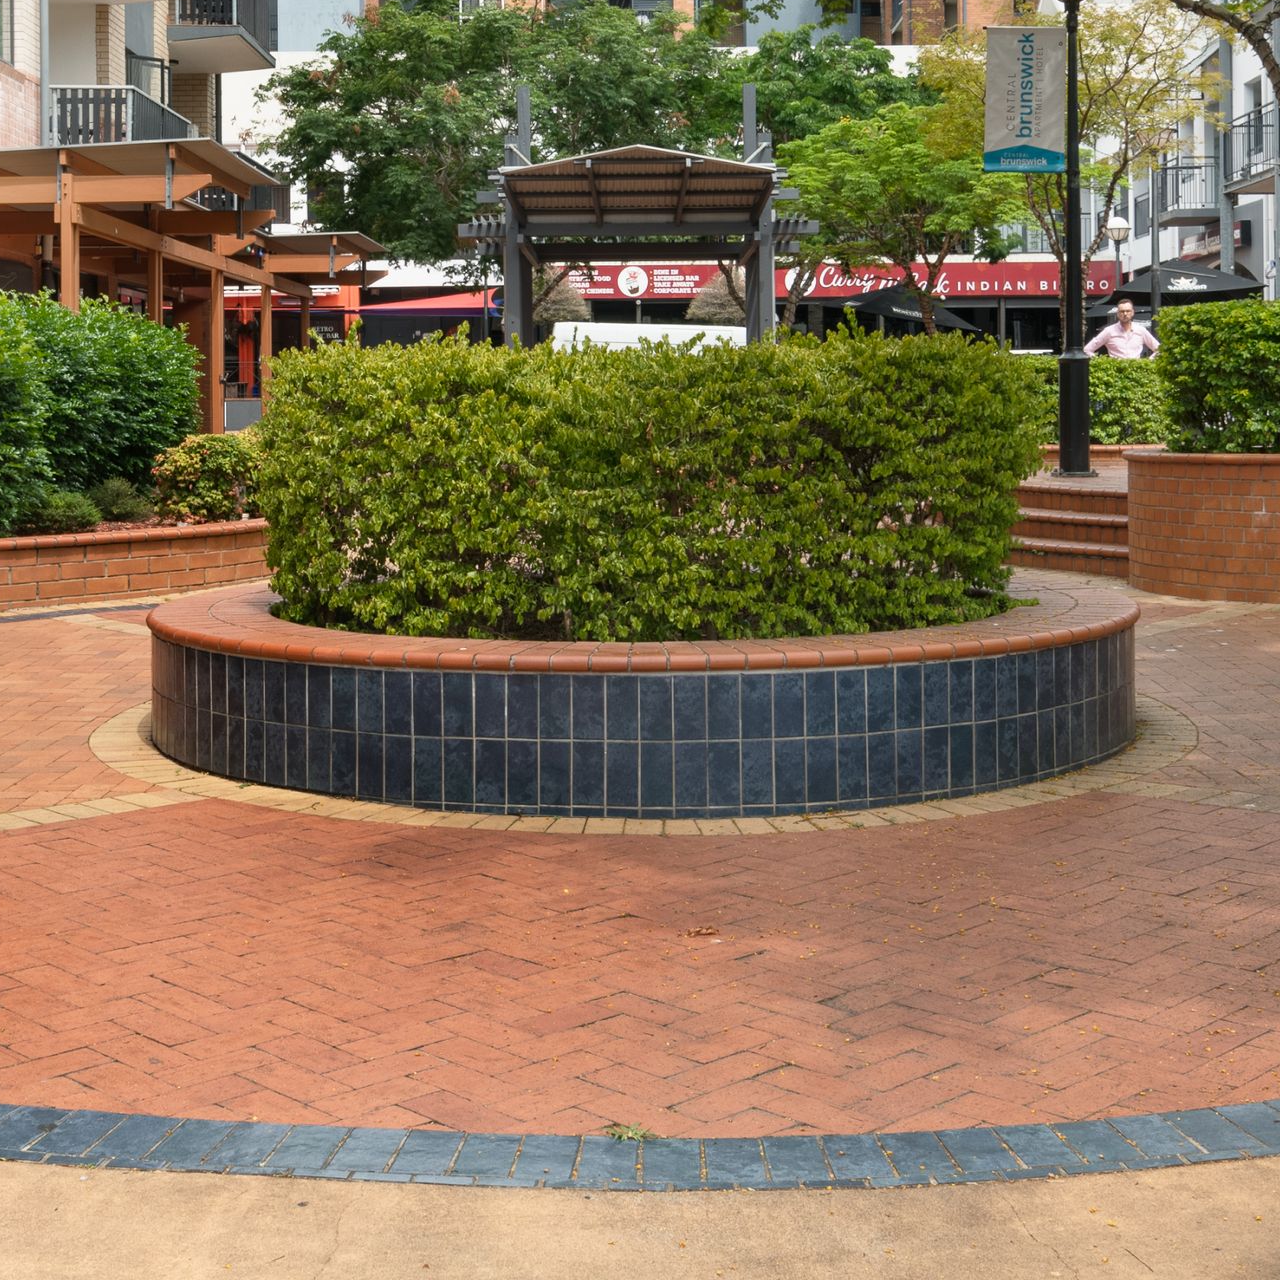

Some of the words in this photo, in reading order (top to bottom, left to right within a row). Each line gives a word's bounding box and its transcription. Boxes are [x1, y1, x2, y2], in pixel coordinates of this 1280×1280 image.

[1036, 47, 1044, 74] HOTEL
[1006, 73, 1017, 132] CENTRAL
[1015, 32, 1035, 138] brunswick
[1034, 86, 1042, 138] APARTMENT
[1000, 157, 1048, 166] brunswick
[819, 266, 876, 293] Curry
[957, 280, 1027, 291] INDIAN
[1039, 280, 1109, 290] BIRO
